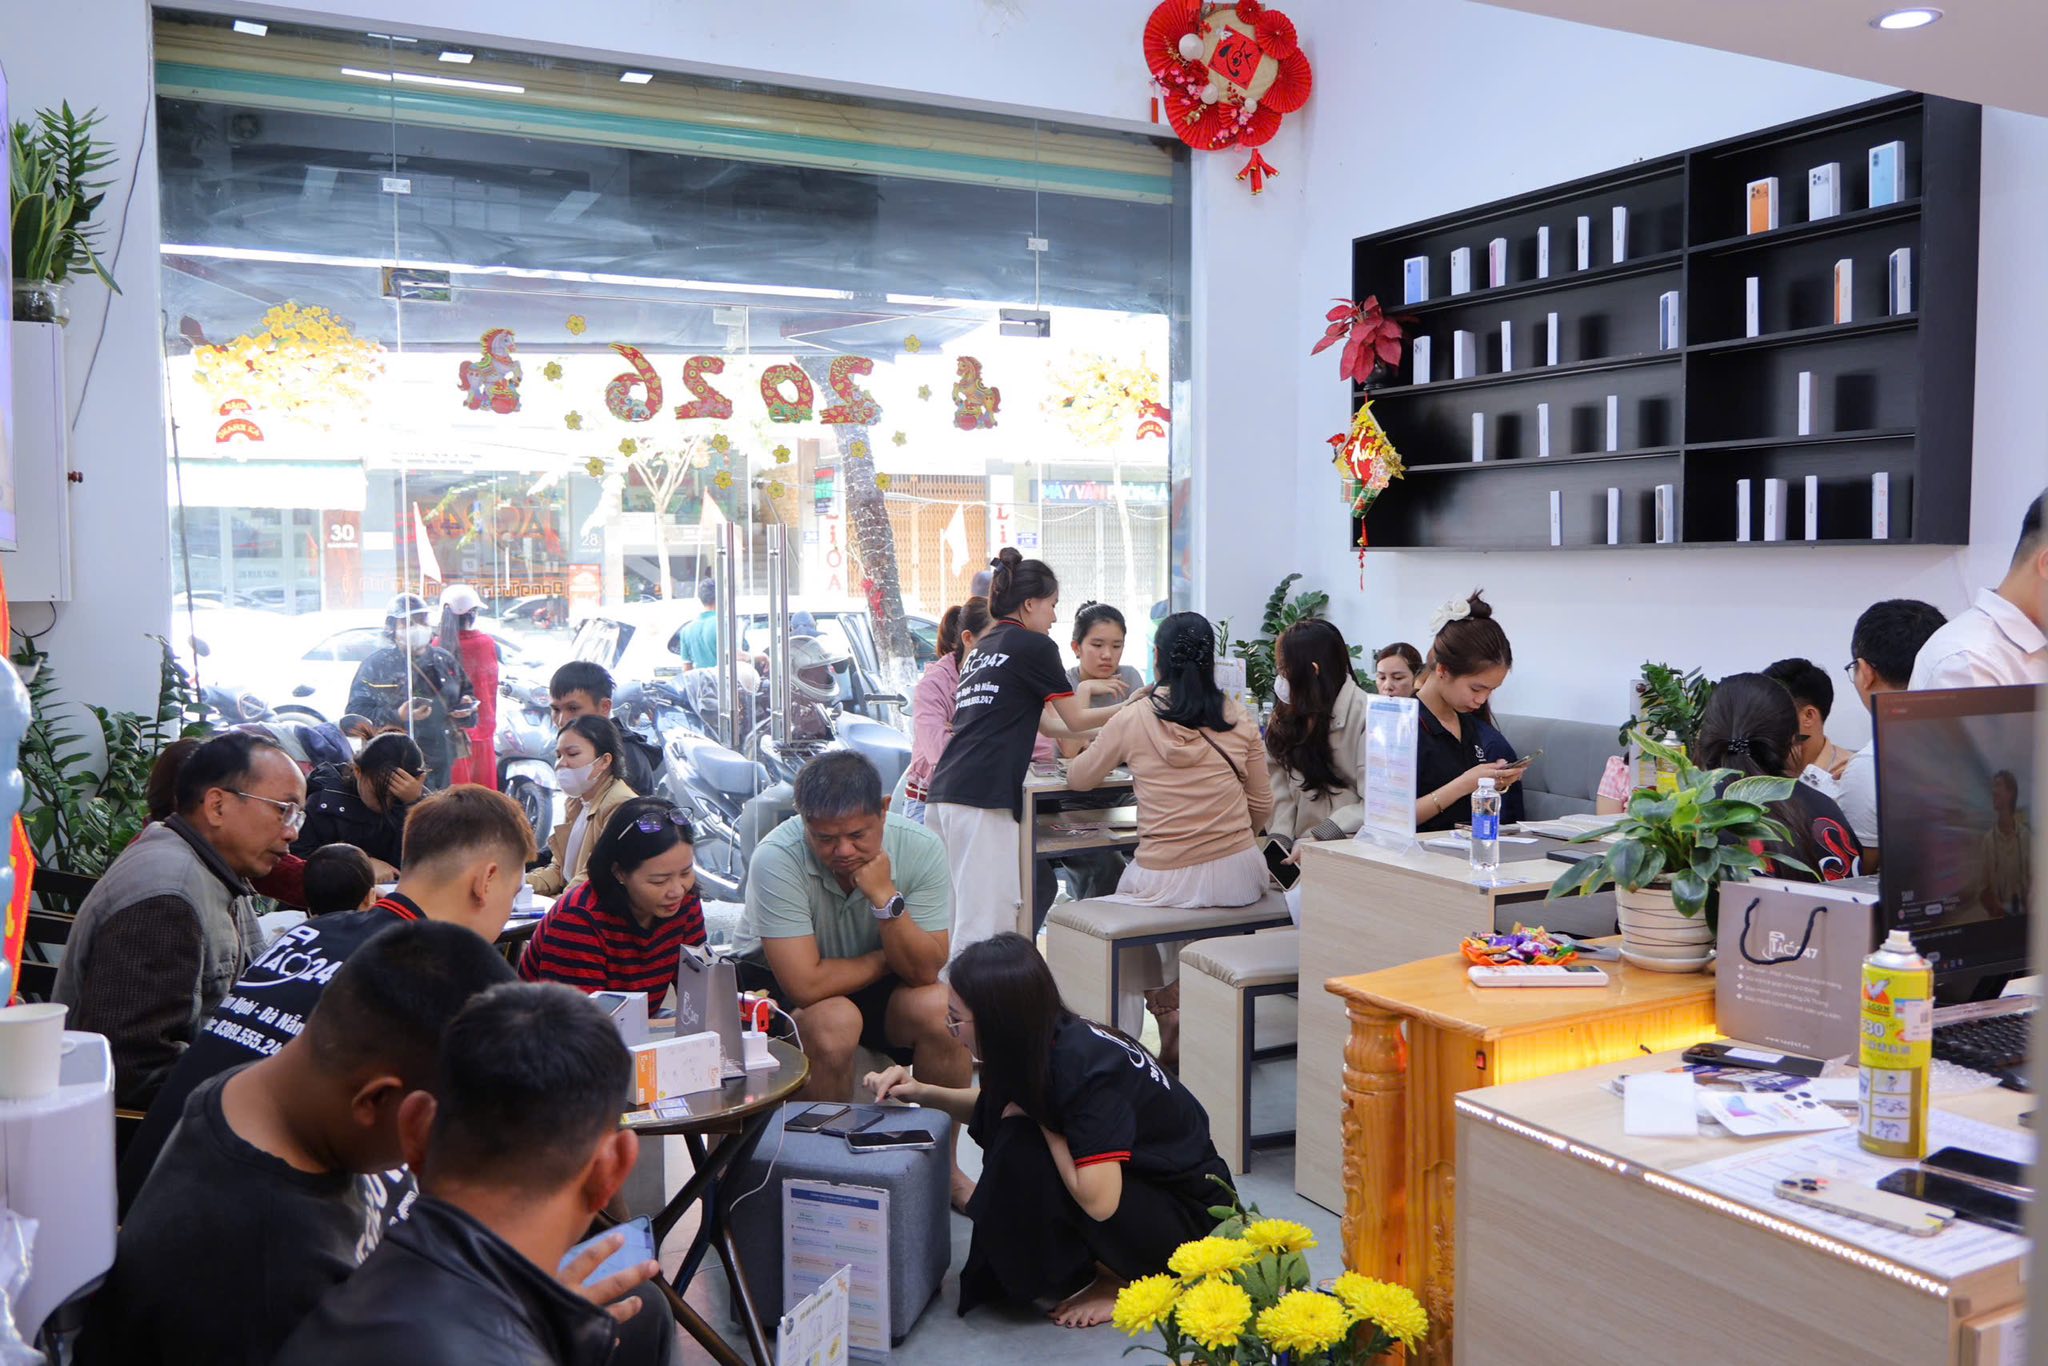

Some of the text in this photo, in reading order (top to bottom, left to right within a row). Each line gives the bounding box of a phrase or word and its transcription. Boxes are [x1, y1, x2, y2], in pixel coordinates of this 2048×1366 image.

[330, 523, 356, 541] 30
[581, 532, 599, 546] 28
[275, 1013, 306, 1036] Nẵn
[213, 1018, 284, 1057] 0369.555.24
